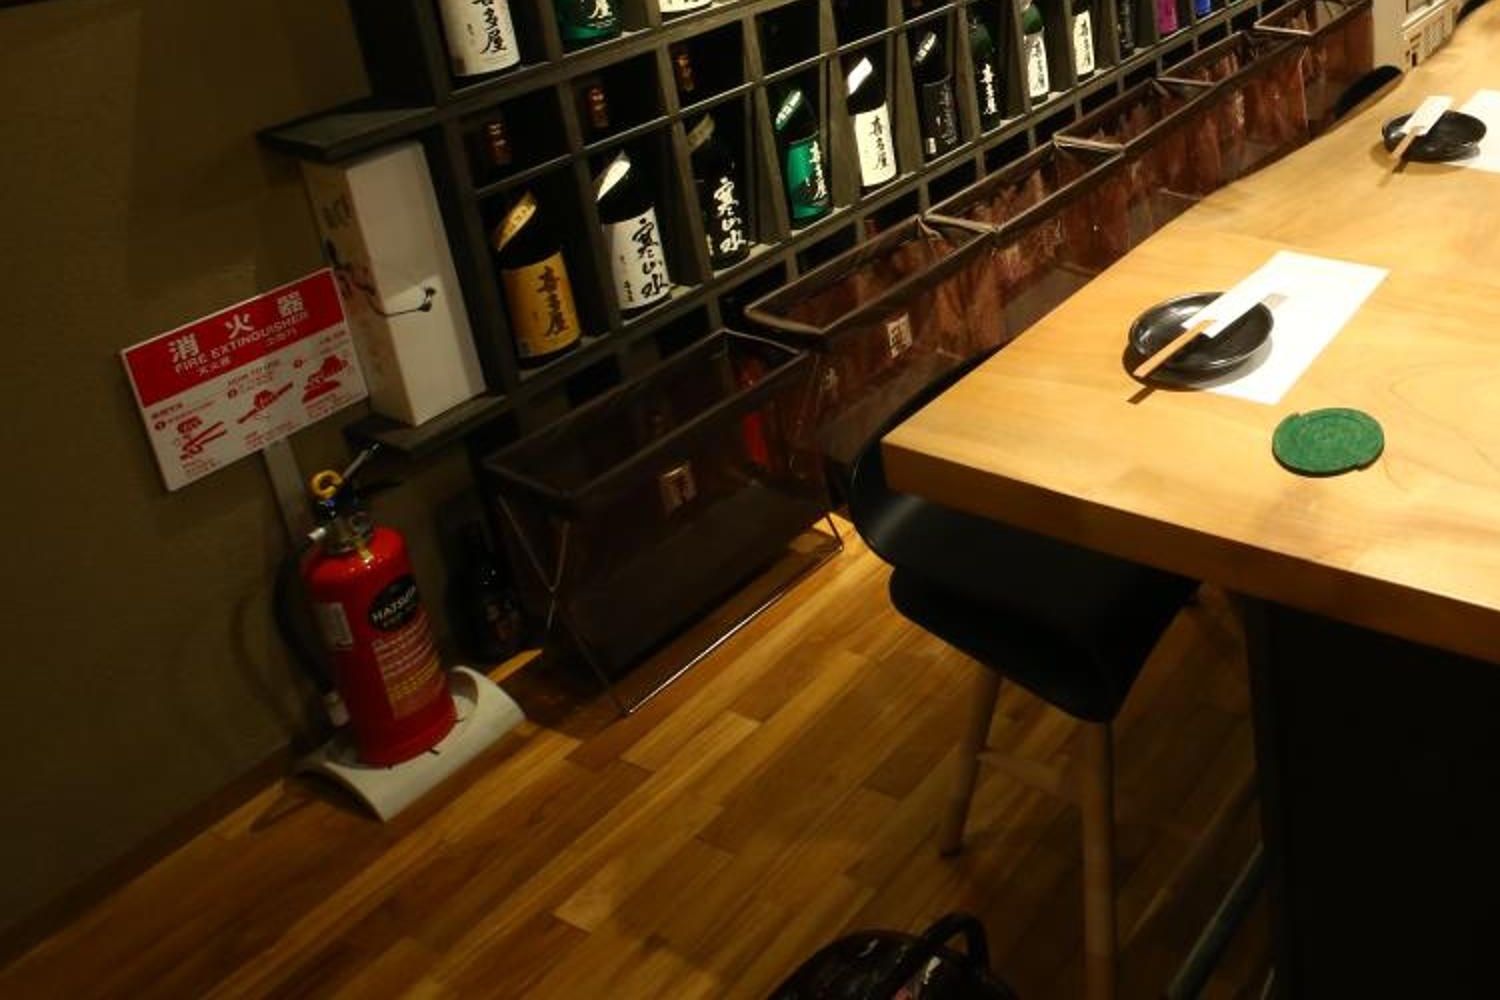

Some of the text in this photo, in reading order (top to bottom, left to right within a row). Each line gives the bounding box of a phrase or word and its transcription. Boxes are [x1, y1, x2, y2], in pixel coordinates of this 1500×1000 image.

[168, 290, 304, 363] 消火器
[175, 351, 208, 374] FIRE
